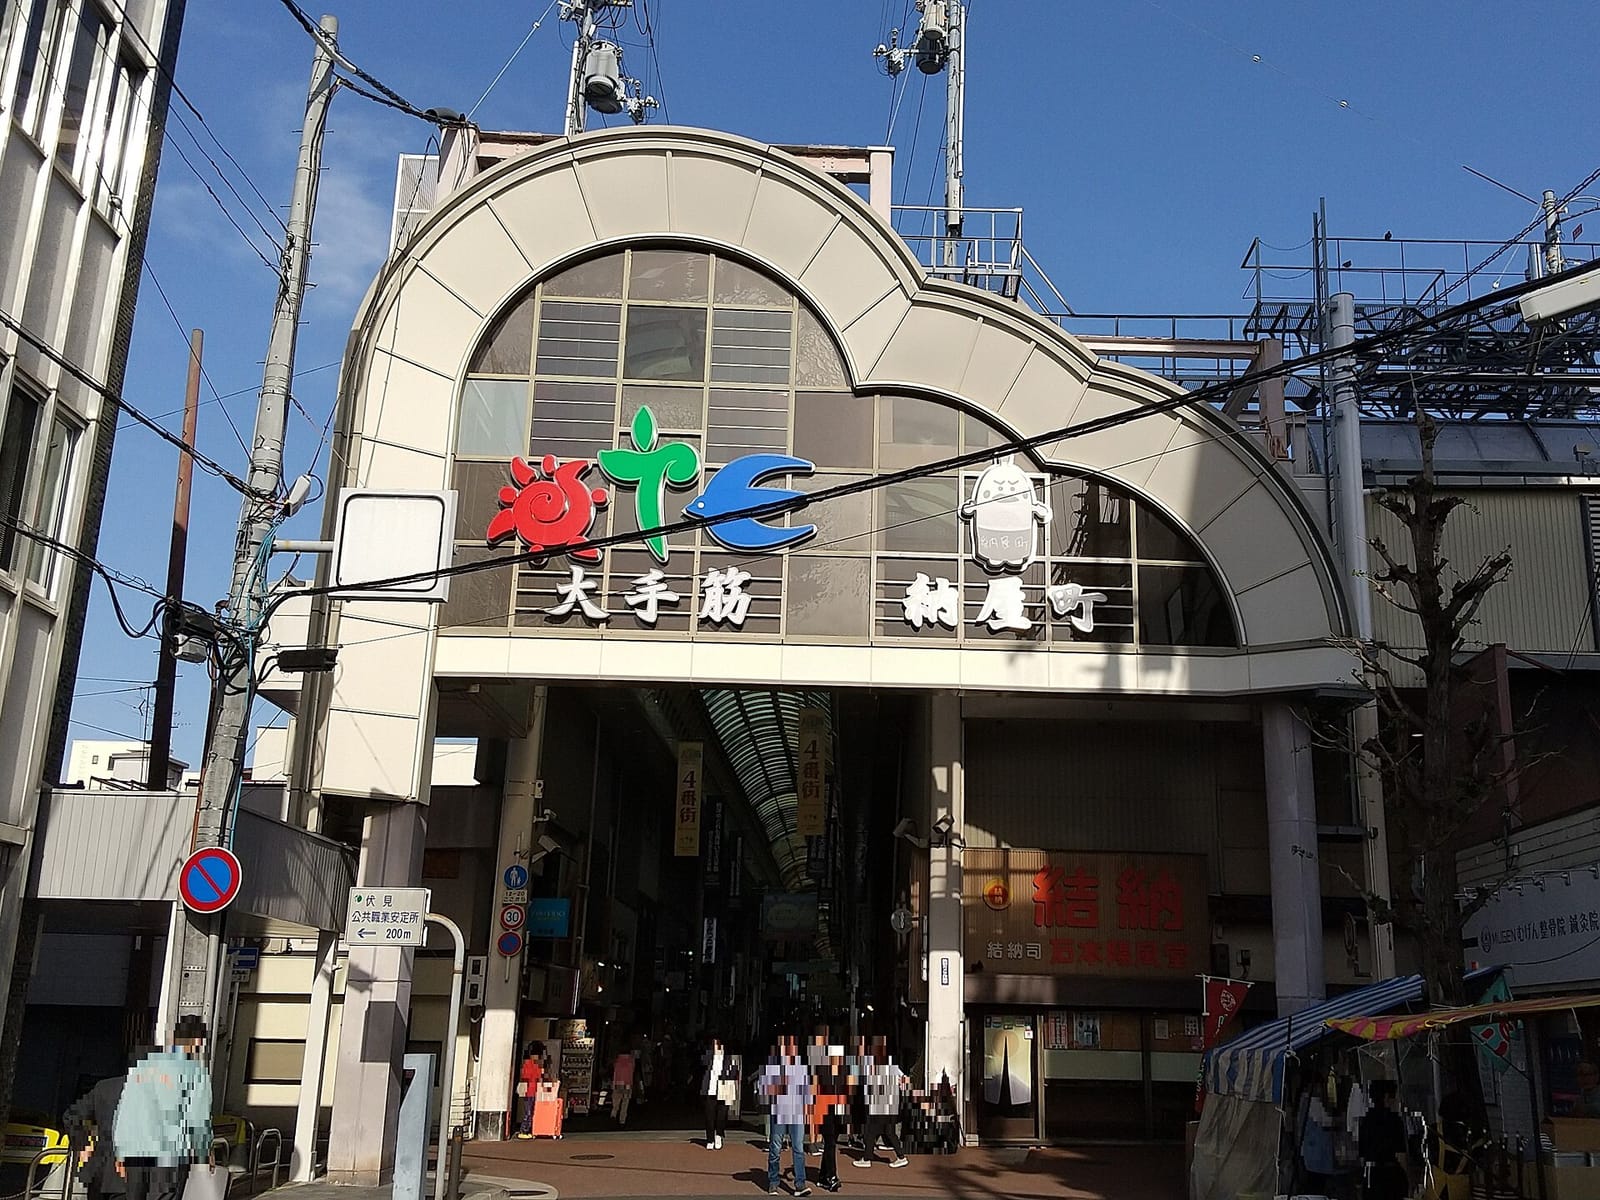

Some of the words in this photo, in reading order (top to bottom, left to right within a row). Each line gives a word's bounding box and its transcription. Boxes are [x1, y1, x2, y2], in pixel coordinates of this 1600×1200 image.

[544, 564, 753, 625] 大手筋
[902, 572, 1108, 633] 納屋町
[802, 739, 820, 800] 4番街
[679, 770, 697, 824] 4番街
[366, 895, 393, 907] 伏見
[1033, 865, 1184, 931] 結納
[352, 911, 419, 923] 公共職業安定所
[386, 928, 411, 939] 200m
[506, 911, 519, 923] 30
[987, 941, 1042, 960] 結納司
